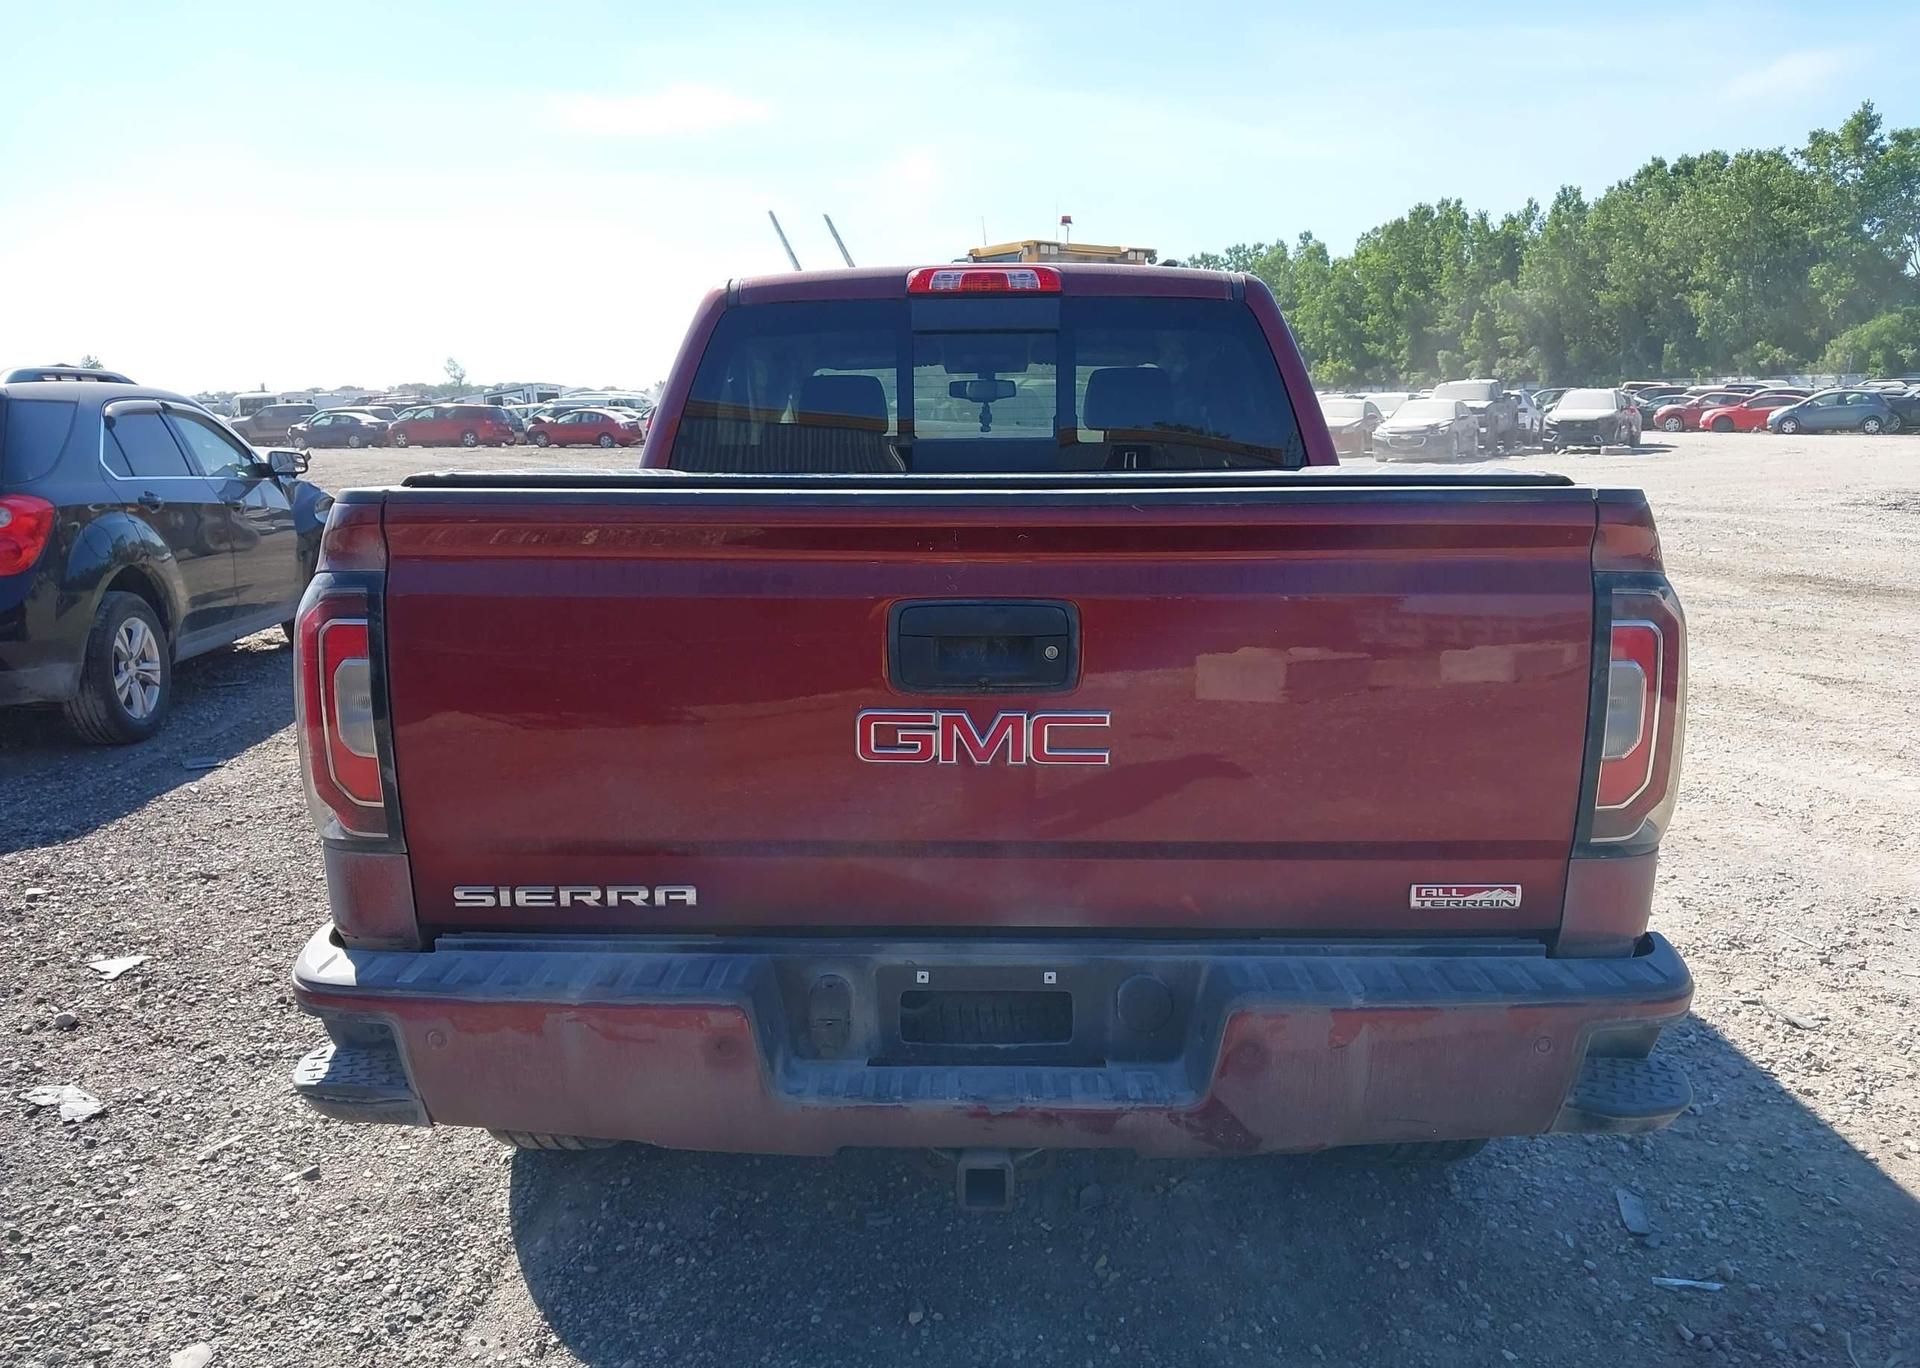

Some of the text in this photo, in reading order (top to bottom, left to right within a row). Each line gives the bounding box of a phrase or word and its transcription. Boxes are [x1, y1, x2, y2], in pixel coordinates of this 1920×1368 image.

[857, 709, 1110, 765] GMC
[453, 885, 697, 907] SIERRA
[1421, 888, 1464, 897] ALL
[1416, 899, 1516, 907] TERRAIN
